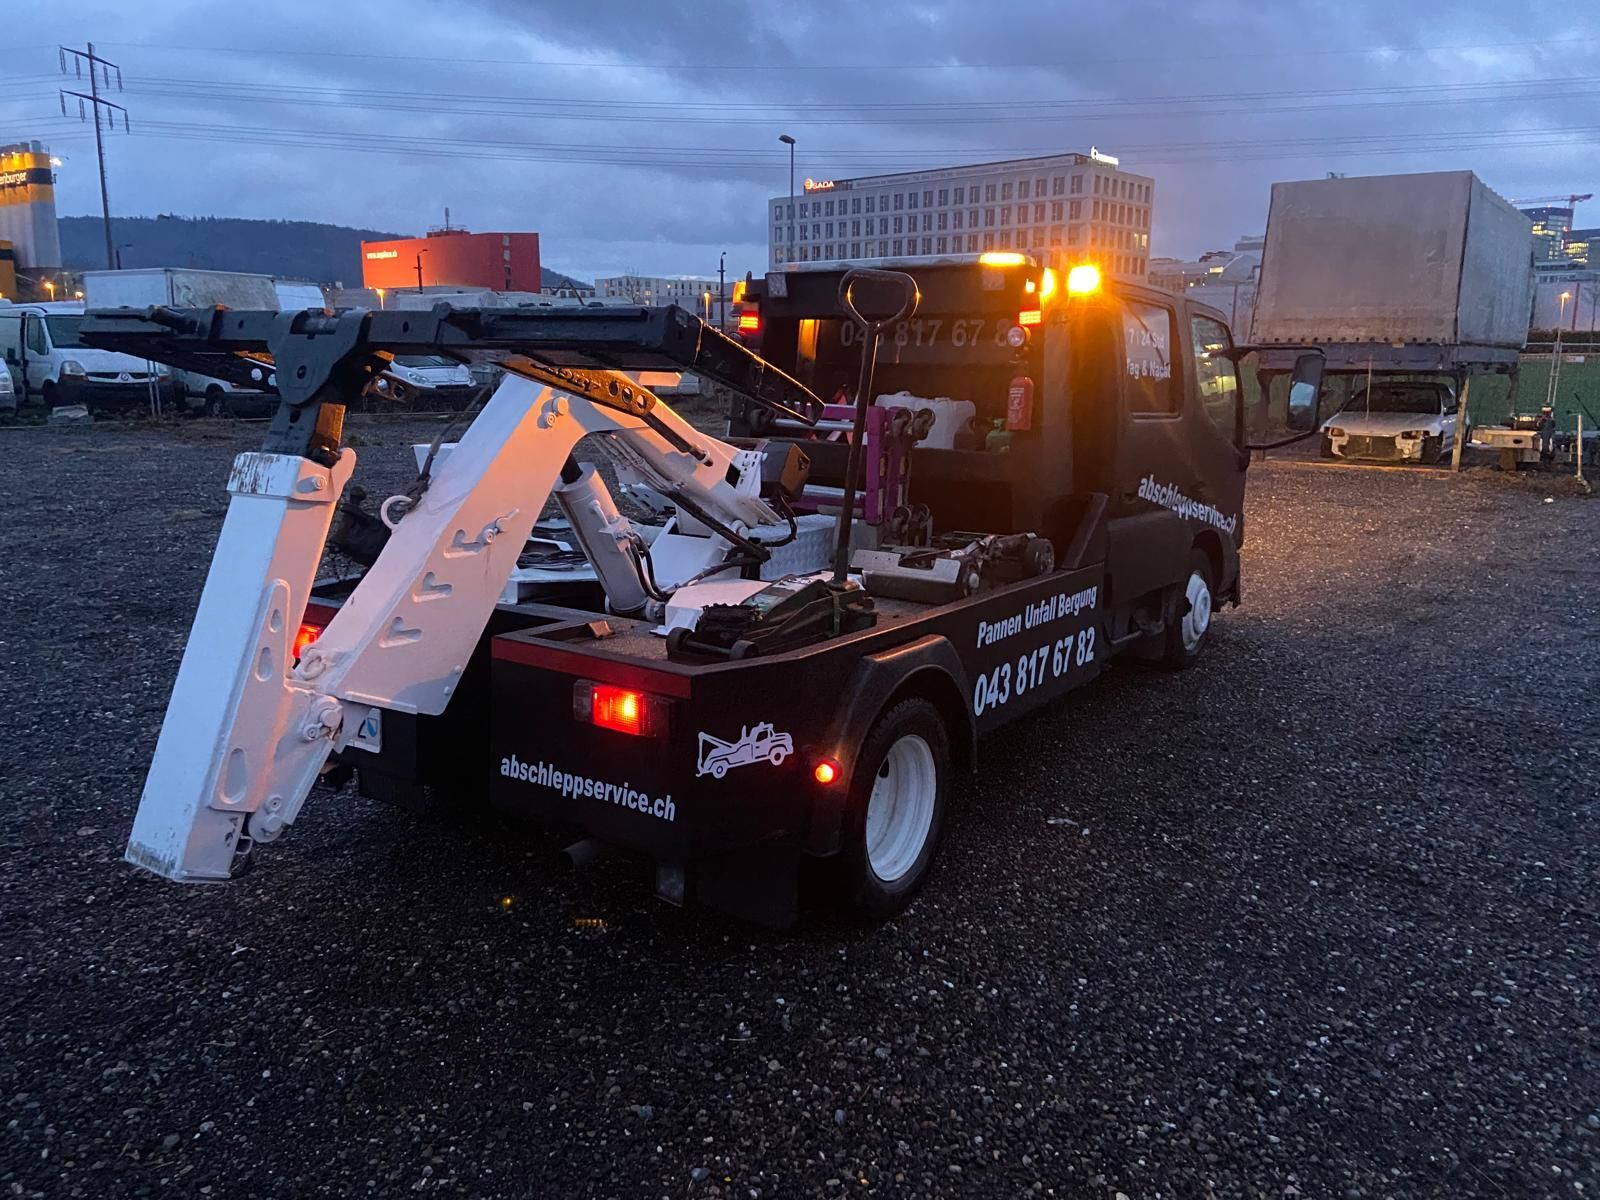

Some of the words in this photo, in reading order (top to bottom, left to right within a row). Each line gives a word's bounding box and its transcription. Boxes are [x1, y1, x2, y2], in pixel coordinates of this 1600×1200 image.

[840, 320, 885, 347] 04
[894, 319, 943, 347] 817
[951, 319, 985, 347] 67
[1141, 360, 1148, 377] &
[1138, 474, 1237, 535] abschleppservice.ch
[976, 613, 1022, 649] Pannen
[1025, 595, 1058, 630] Unfall
[1057, 585, 1098, 617] Bergung
[974, 662, 1012, 717] 043
[1015, 645, 1050, 696] 817
[1052, 634, 1074, 678] 67
[1076, 626, 1096, 667] 82
[500, 754, 676, 822] abschleppservice.ch
